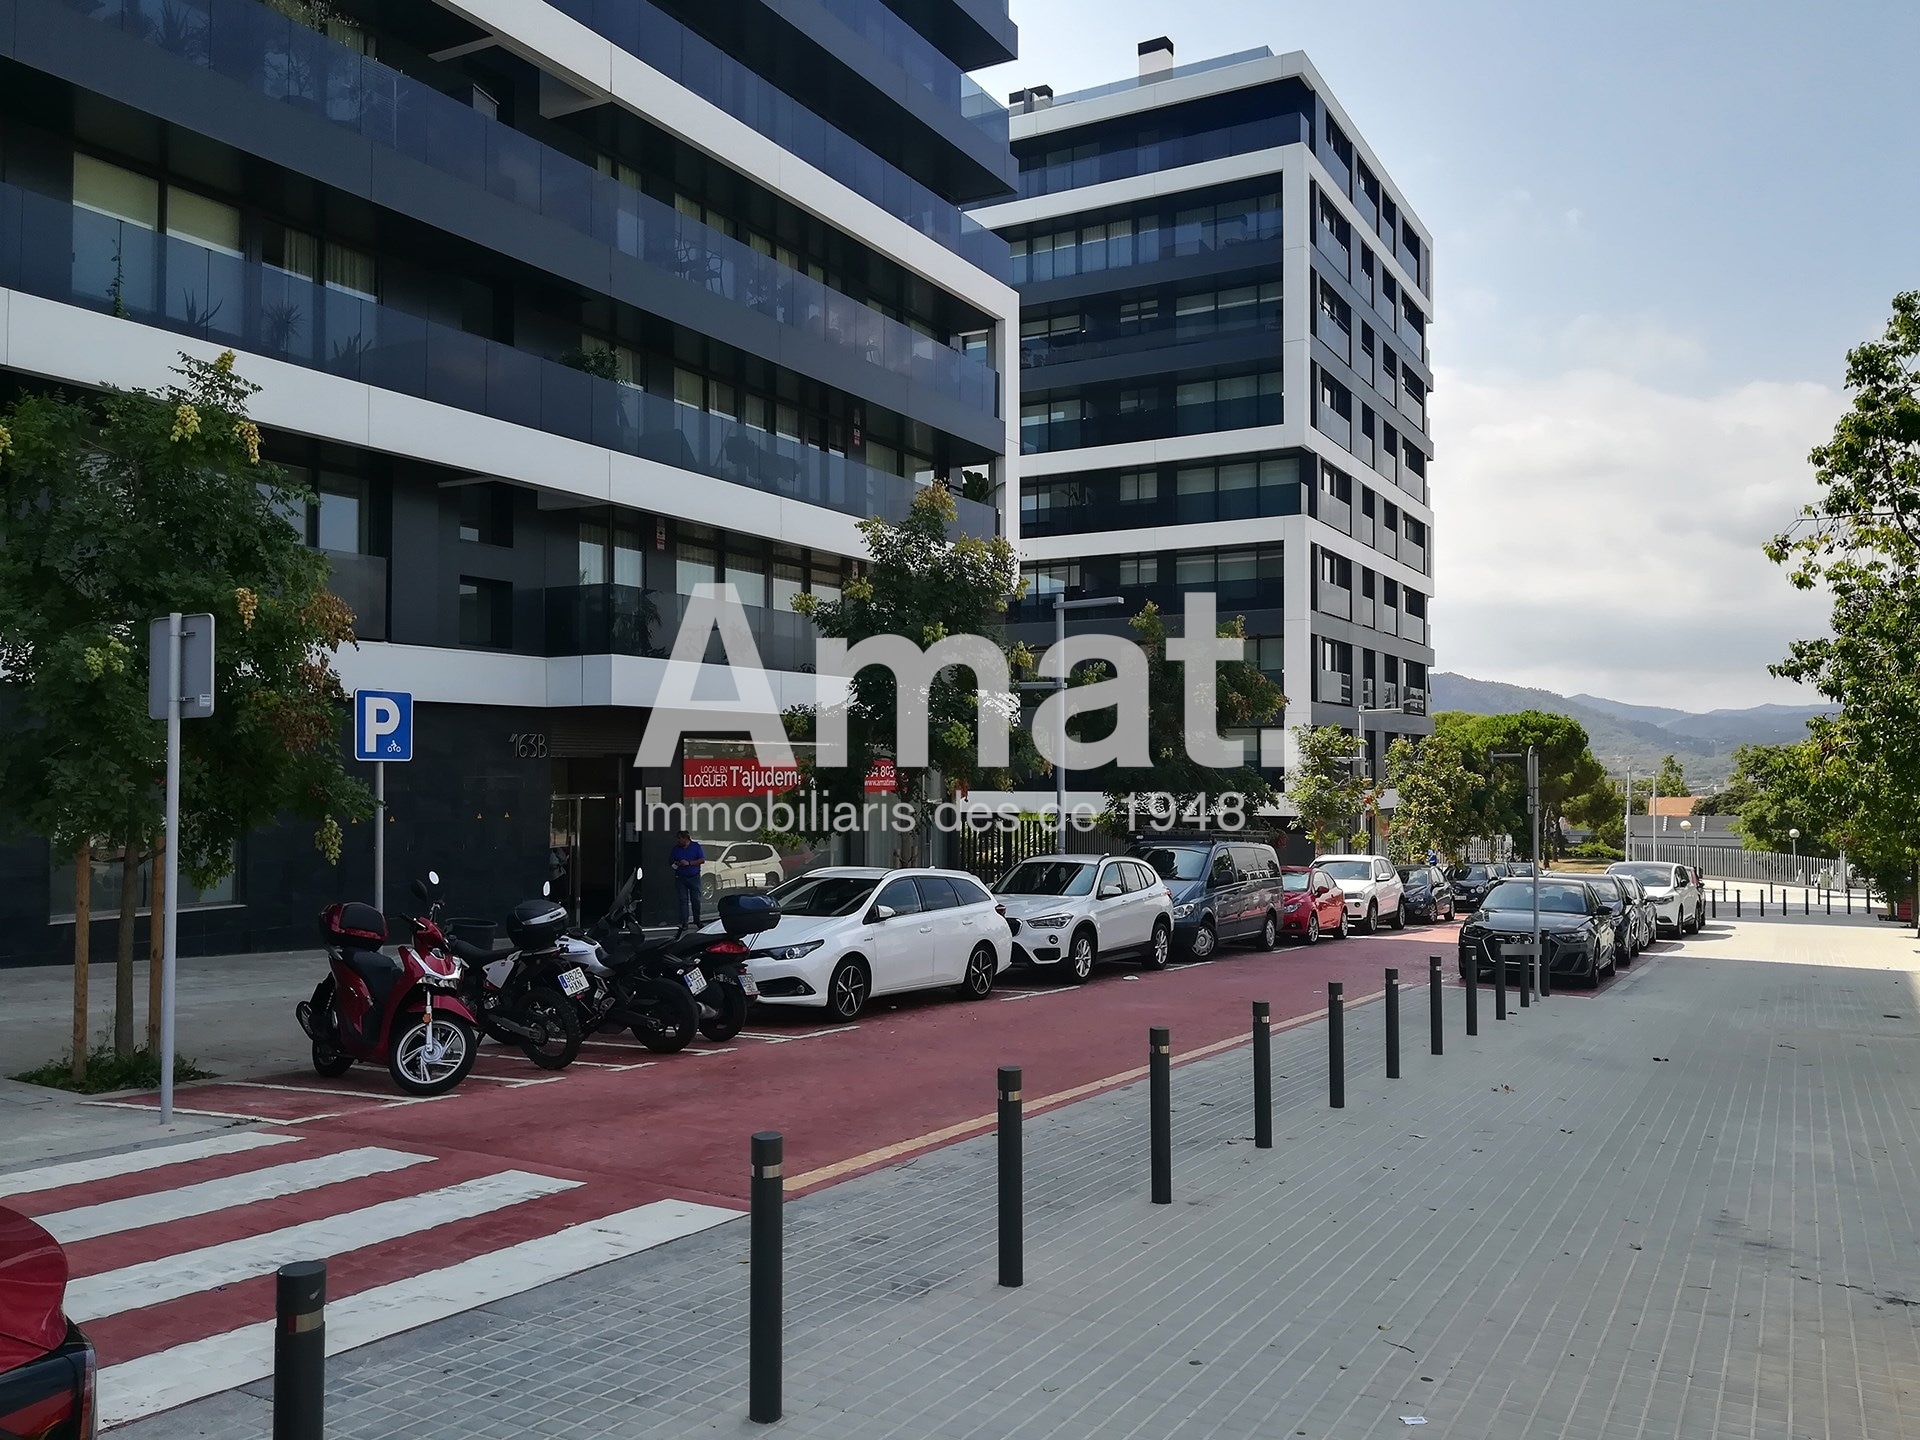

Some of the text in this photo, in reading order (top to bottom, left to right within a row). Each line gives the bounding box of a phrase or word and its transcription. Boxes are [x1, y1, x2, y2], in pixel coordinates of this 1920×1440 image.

[365, 697, 400, 752] P
[509, 733, 548, 758] 163B
[700, 765, 728, 774] LOCAL EN
[683, 774, 728, 788] LLOGUER
